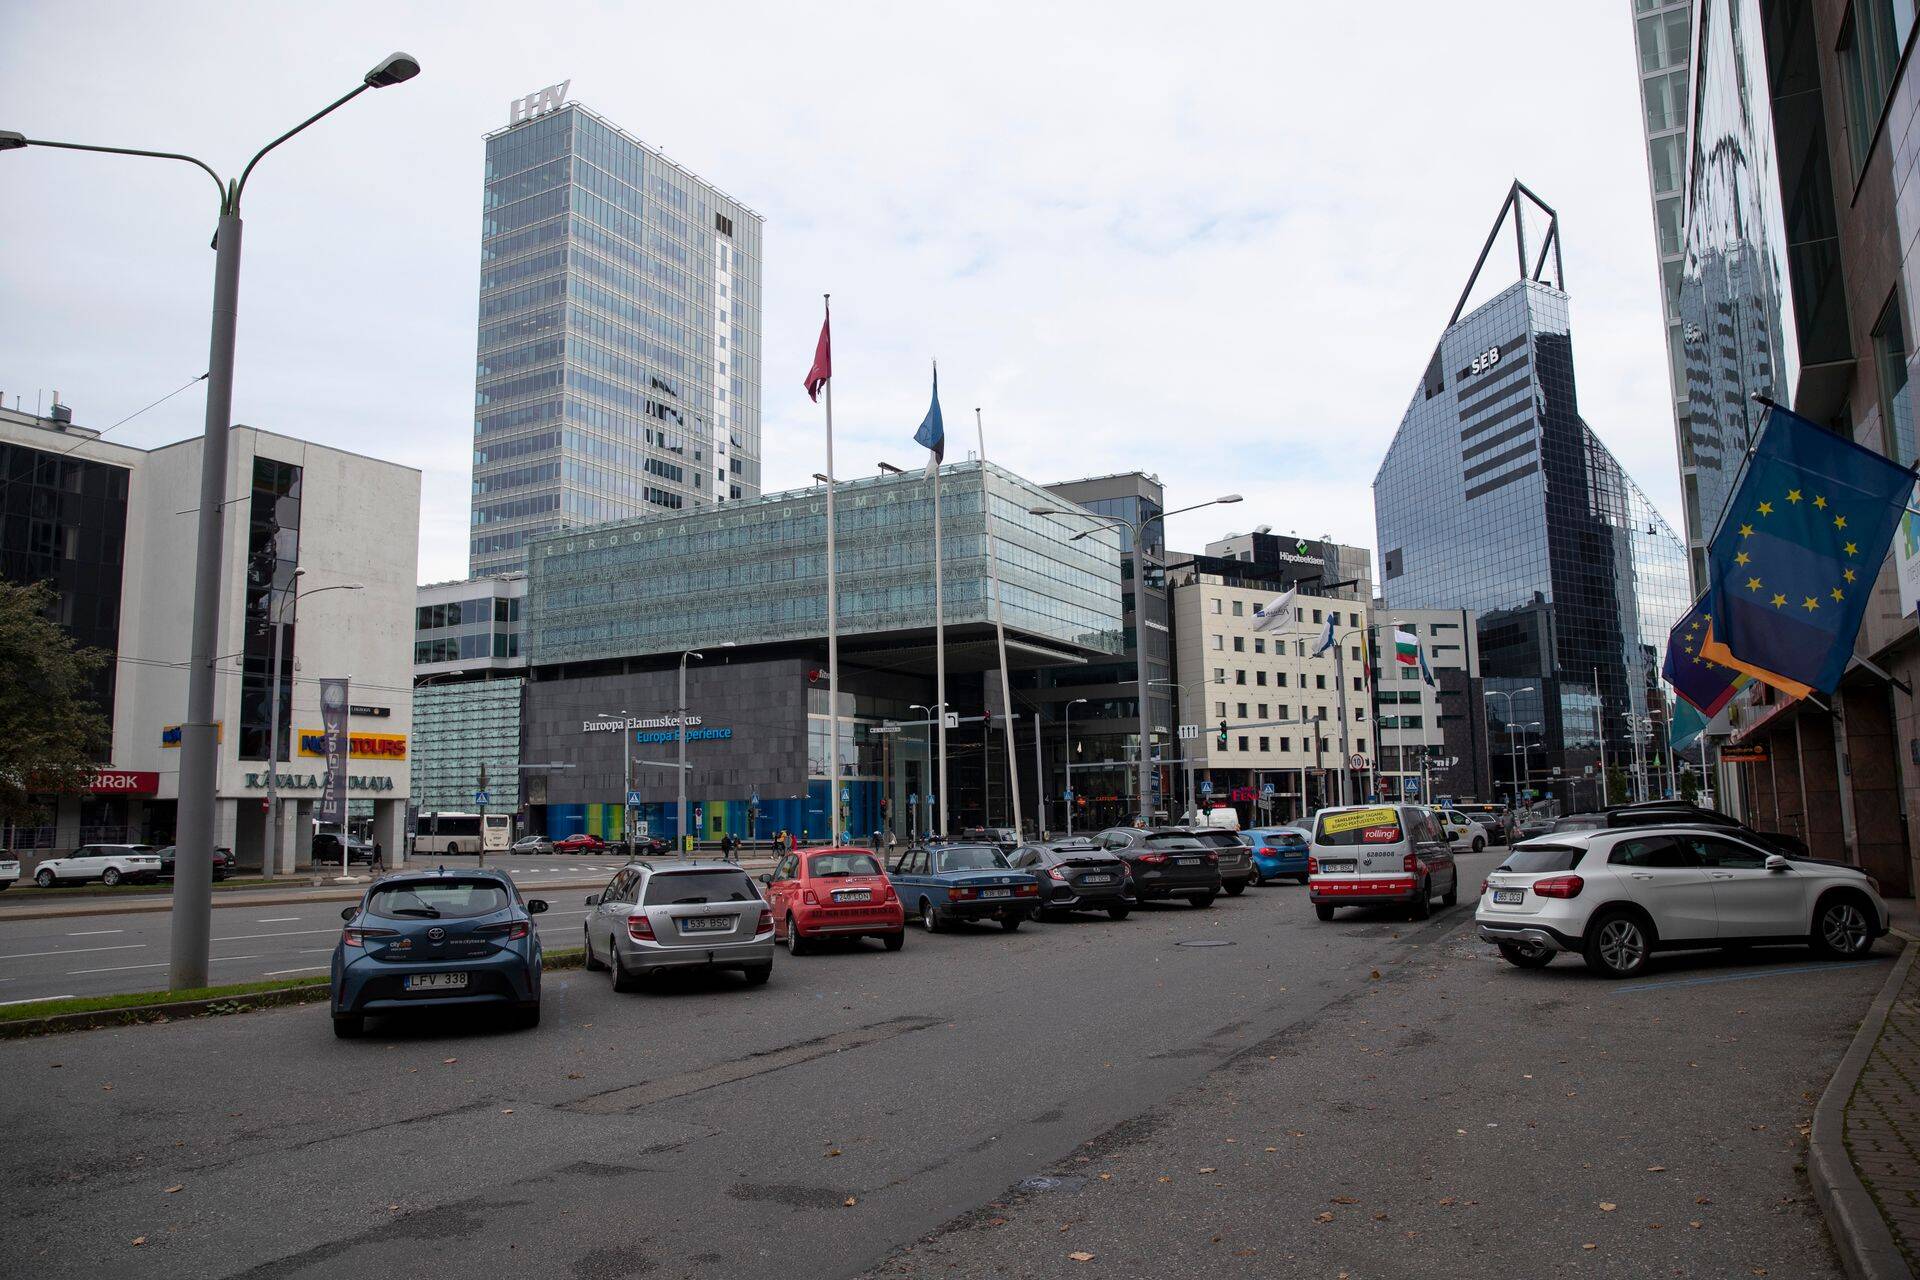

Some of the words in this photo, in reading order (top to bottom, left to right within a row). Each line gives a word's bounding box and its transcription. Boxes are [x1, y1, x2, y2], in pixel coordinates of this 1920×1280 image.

[1472, 347, 1500, 375] SEB
[583, 720, 624, 733] Euroopa
[637, 730, 672, 744] Europa
[675, 727, 732, 744] Eperience
[1366, 829, 1395, 839] rolling!
[690, 919, 706, 928] 535
[709, 918, 729, 927] BSC
[411, 974, 437, 986] LFV
[444, 973, 466, 985] 338
